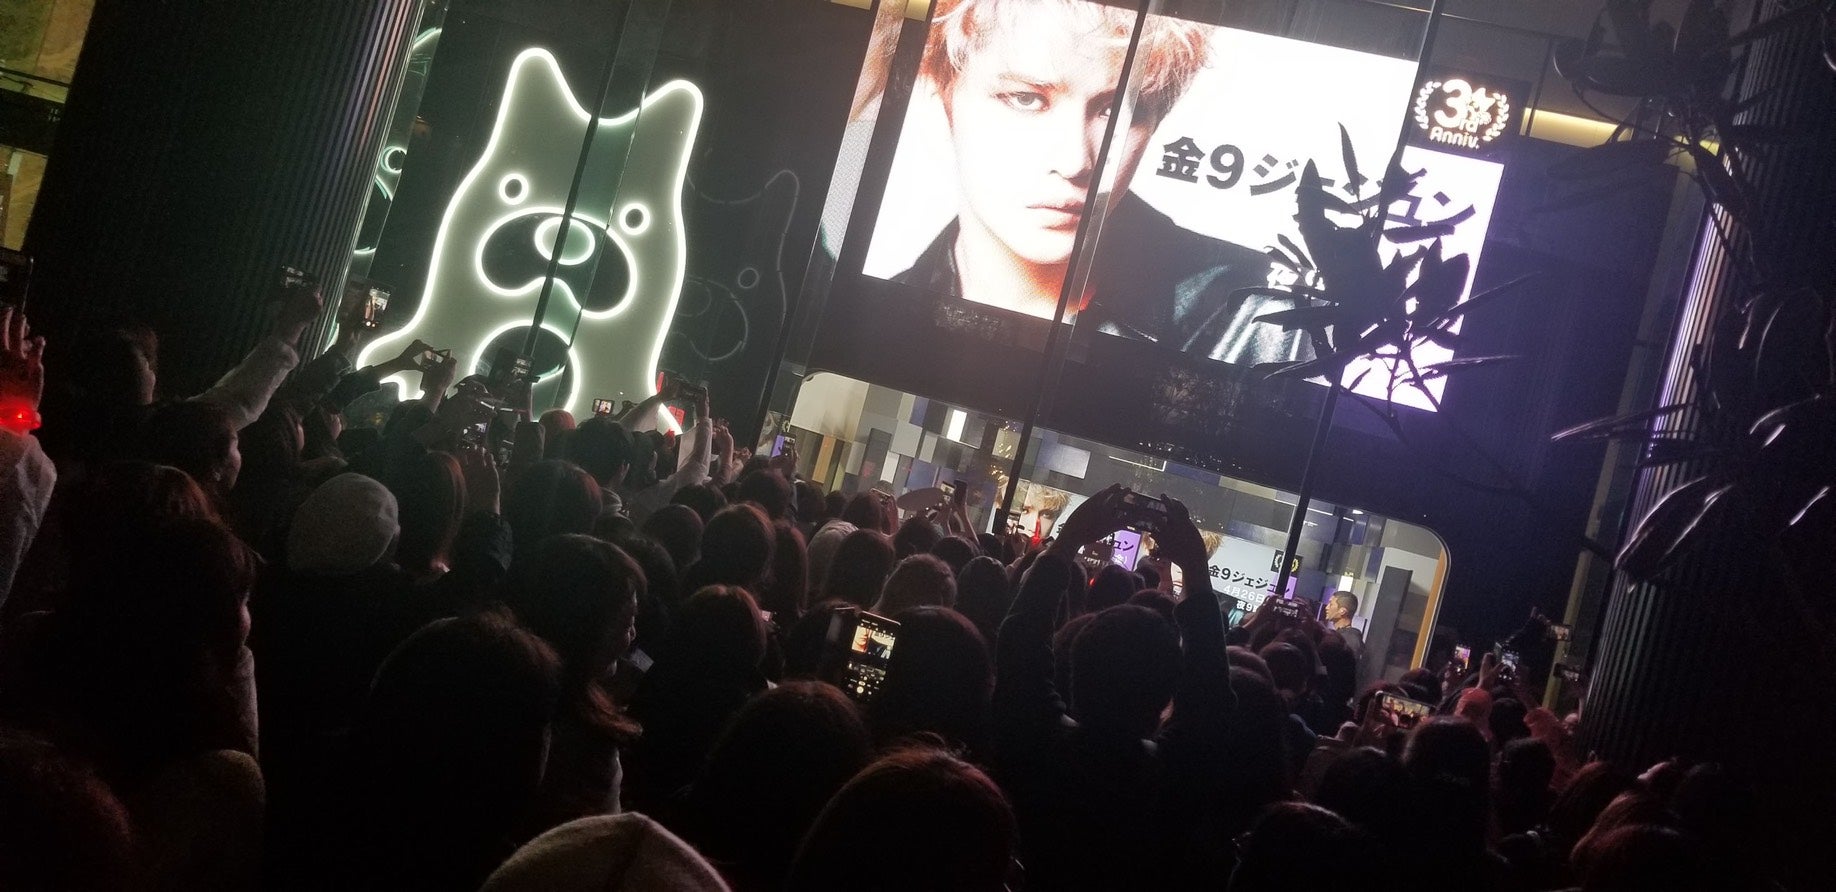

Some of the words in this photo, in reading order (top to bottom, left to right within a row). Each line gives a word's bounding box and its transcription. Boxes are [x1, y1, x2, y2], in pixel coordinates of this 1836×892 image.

[1429, 126, 1480, 149] Anniv.
[1208, 564, 1290, 593] 金9ジェジュ
